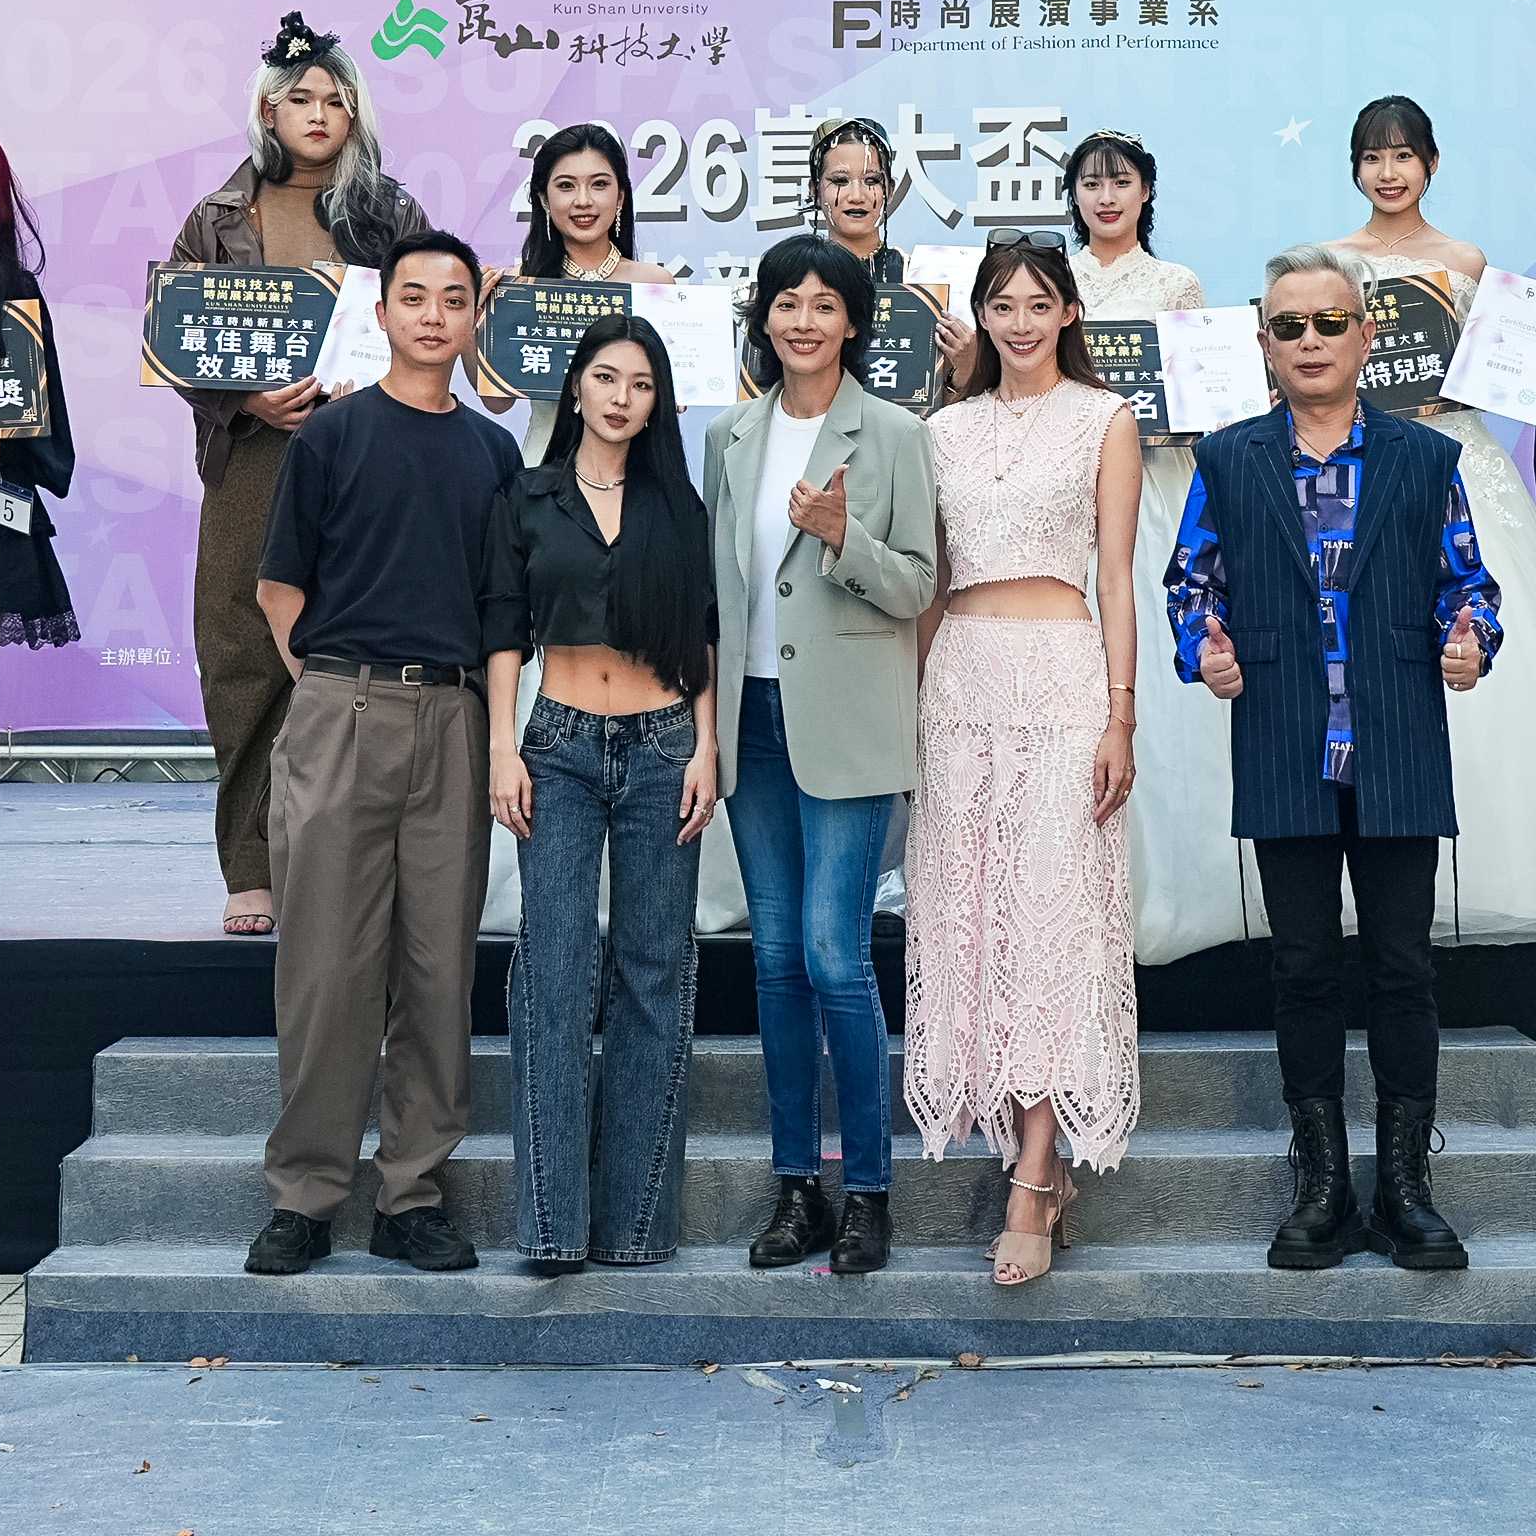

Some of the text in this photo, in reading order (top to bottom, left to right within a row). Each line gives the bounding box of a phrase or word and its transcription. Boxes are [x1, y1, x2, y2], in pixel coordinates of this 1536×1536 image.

[553, 2, 709, 17] Kun Shan University
[890, 33, 1219, 55] Department of Fashion and Performance
[510, 103, 1073, 231] 226崑大盃
[204, 277, 294, 292] 崑山科技大學
[204, 290, 293, 304] 時尚展演事業系
[535, 290, 624, 305] 崑山科技大學
[182, 315, 314, 330] 崑大盃時尚新星大賽
[180, 328, 310, 357] 最佳舞台
[1088, 346, 1142, 357] 演事業系
[196, 354, 292, 382] 效果獎
[868, 356, 898, 389] 名
[1130, 390, 1158, 420] 名
[2, 499, 14, 522] 5
[1330, 742, 1353, 751] PLAY
